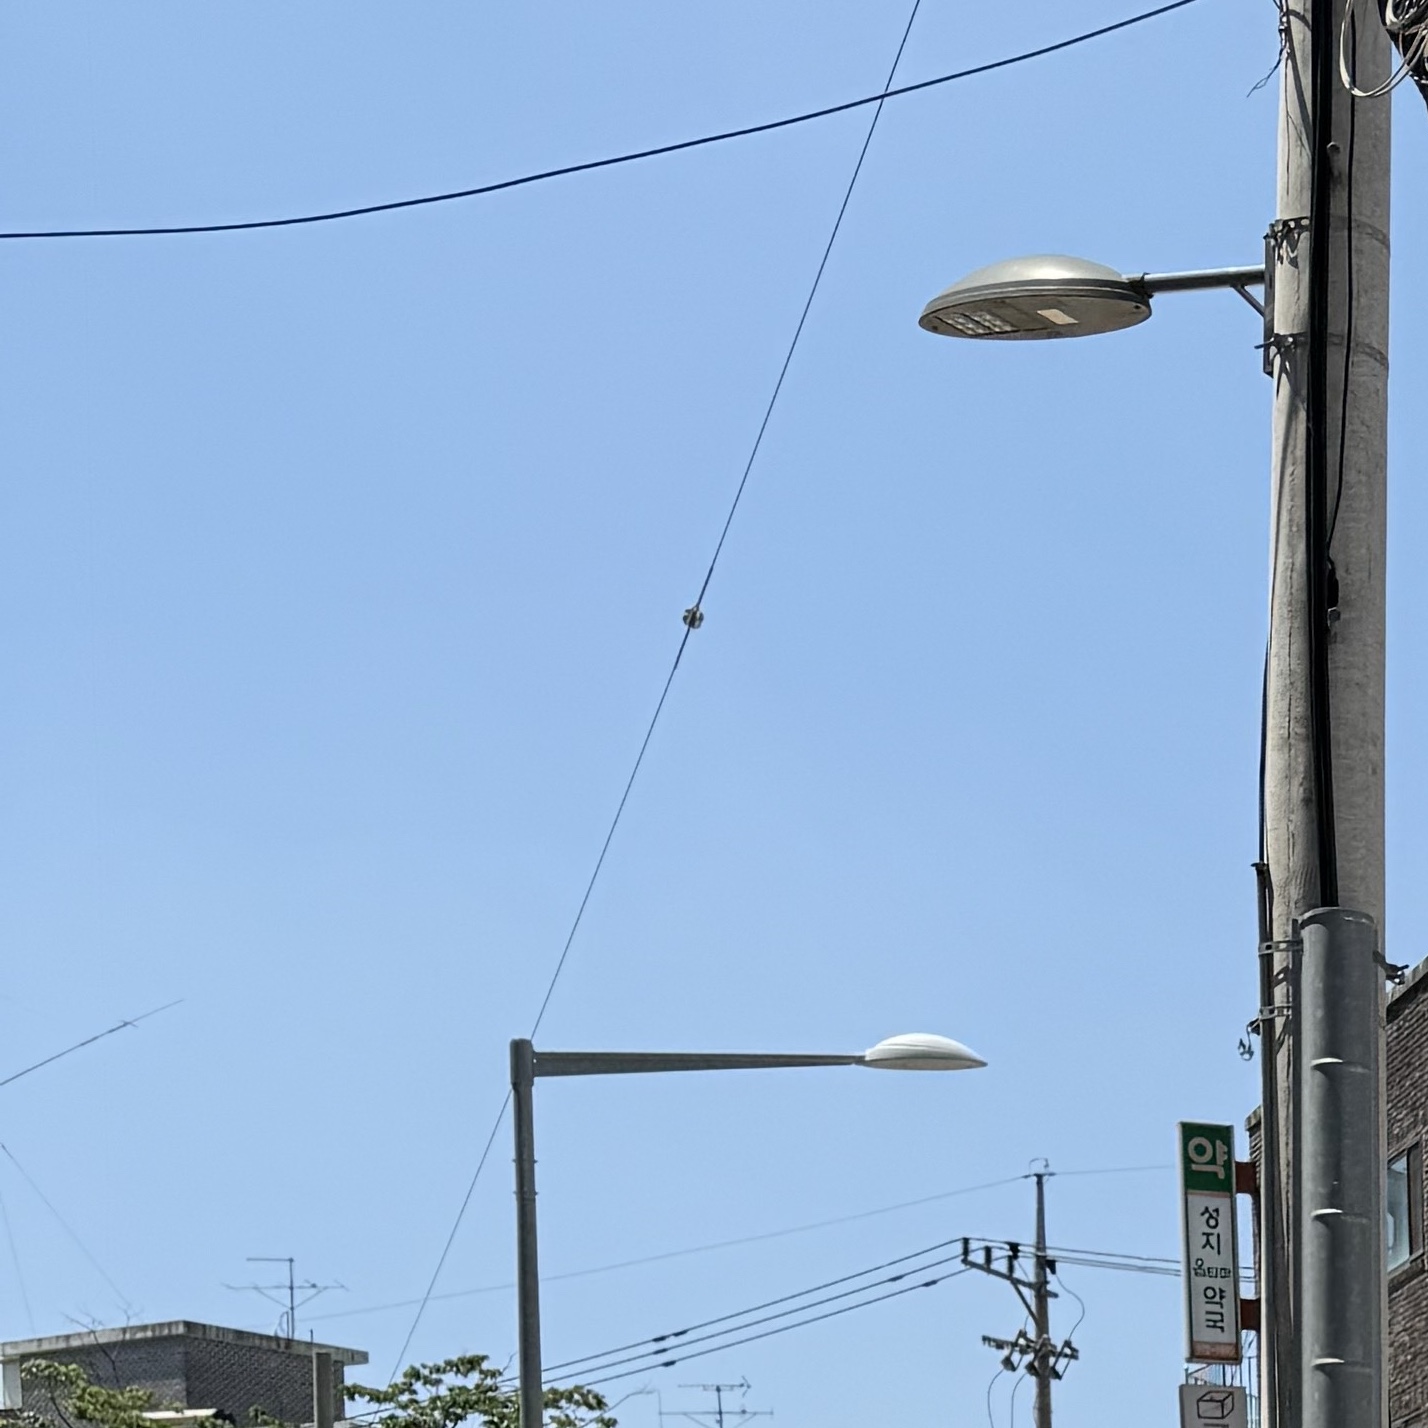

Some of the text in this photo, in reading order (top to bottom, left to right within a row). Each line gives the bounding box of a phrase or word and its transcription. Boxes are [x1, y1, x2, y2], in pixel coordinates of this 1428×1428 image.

[1187, 1136, 1228, 1180] 약
[1200, 1206, 1221, 1255] 성지
[1203, 1286, 1226, 1333] 약국
